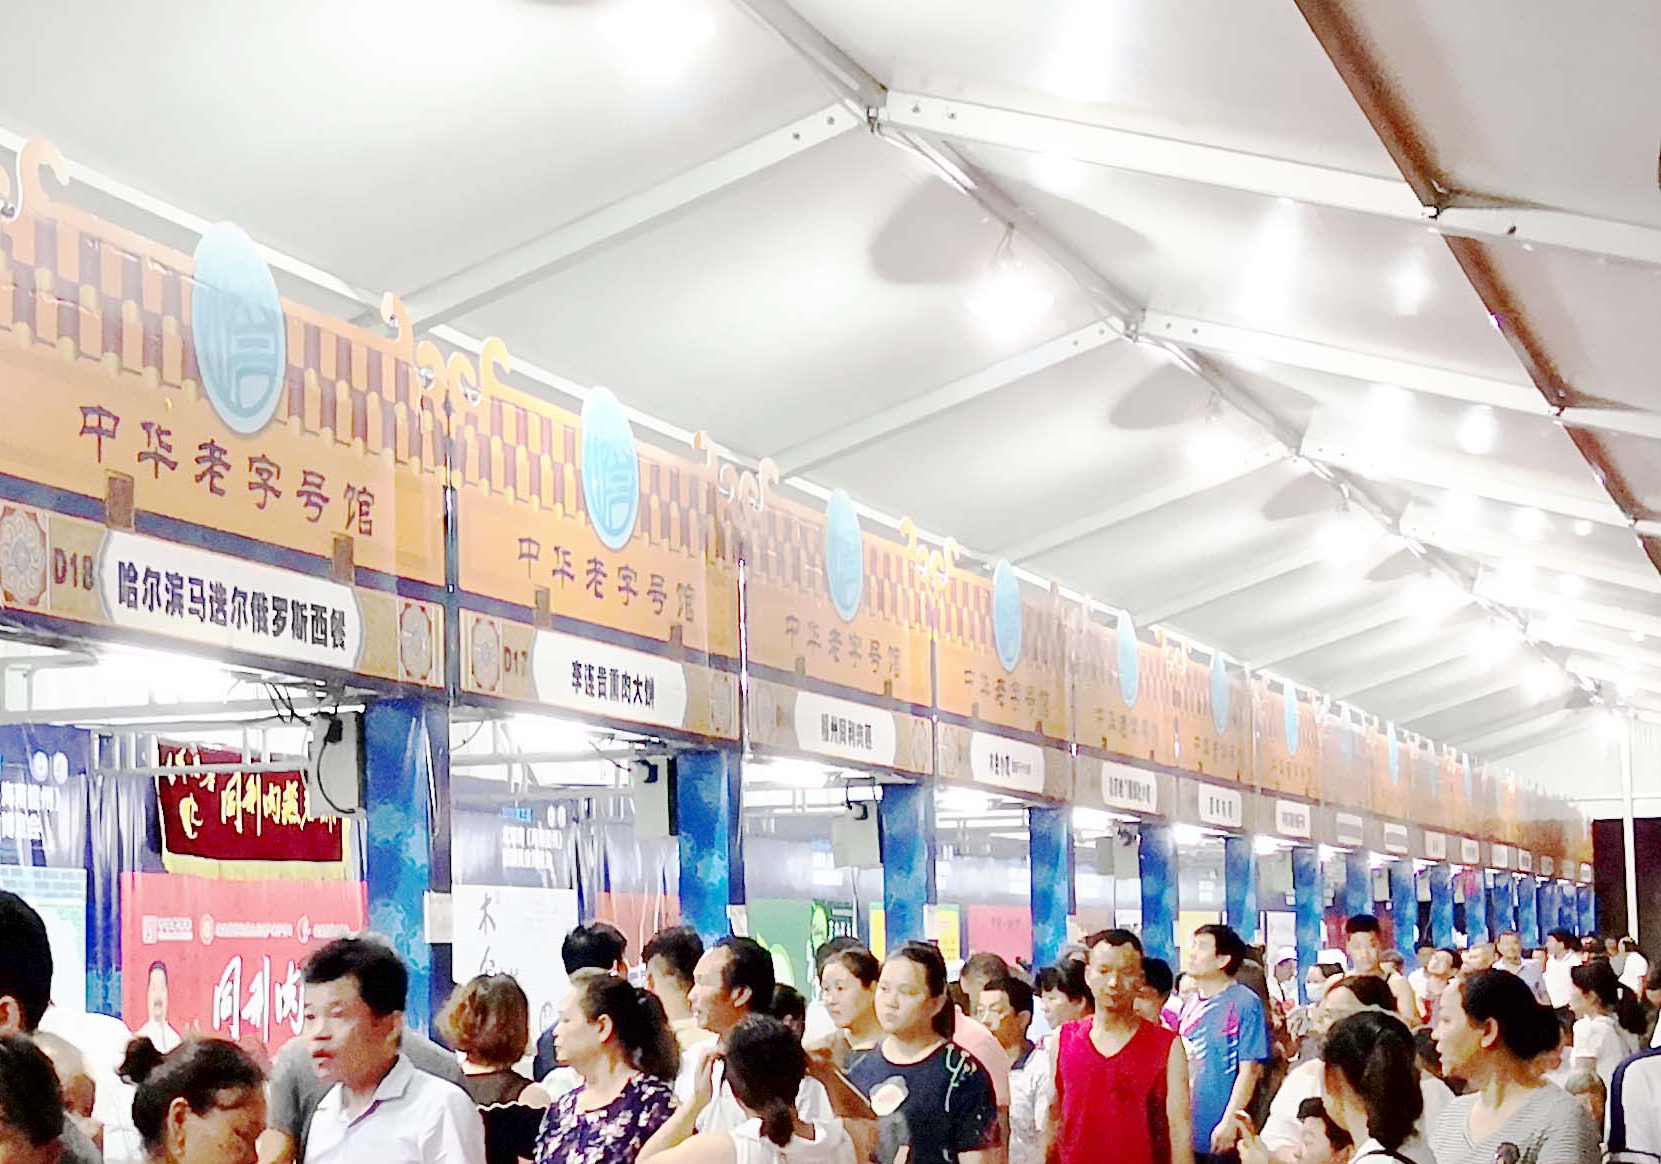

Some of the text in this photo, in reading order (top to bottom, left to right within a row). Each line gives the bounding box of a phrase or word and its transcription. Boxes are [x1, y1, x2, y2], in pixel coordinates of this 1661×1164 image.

[79, 405, 376, 536] 中华老字号馆
[53, 547, 94, 591] D18
[518, 537, 695, 622] 中华老字号馆
